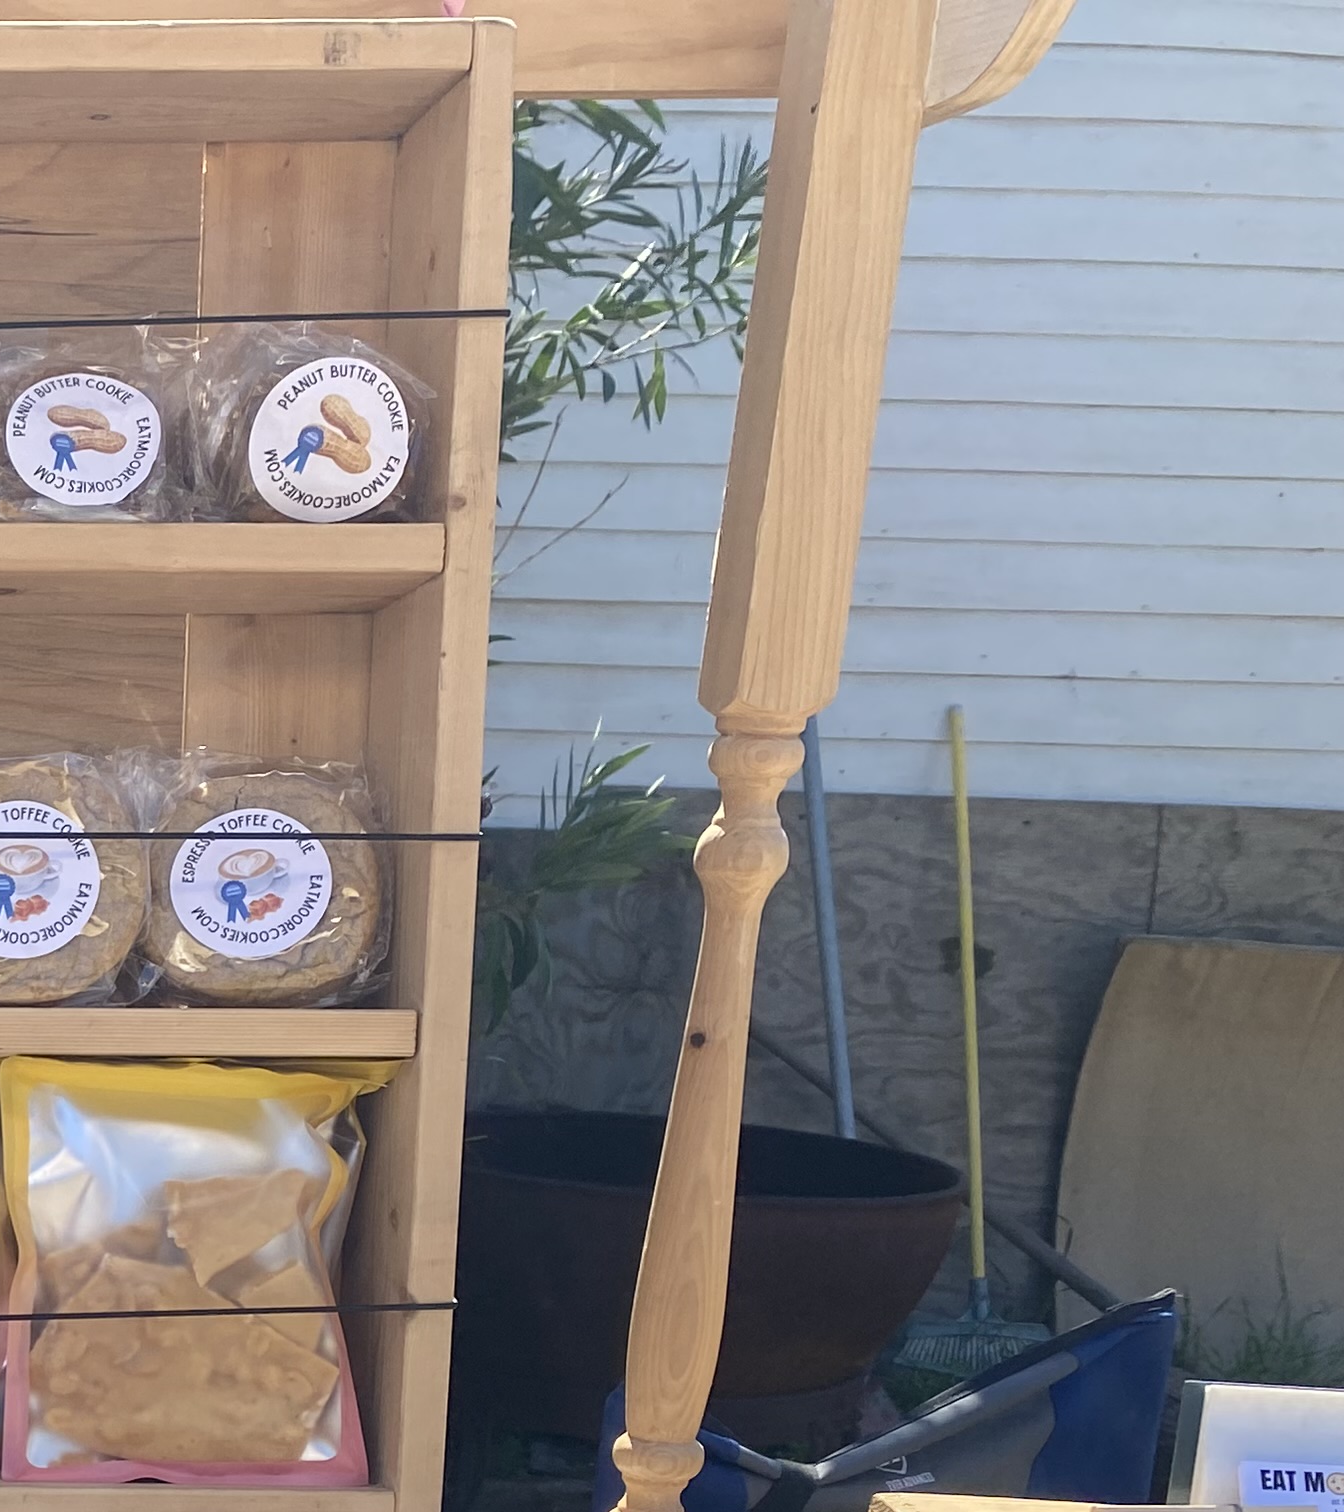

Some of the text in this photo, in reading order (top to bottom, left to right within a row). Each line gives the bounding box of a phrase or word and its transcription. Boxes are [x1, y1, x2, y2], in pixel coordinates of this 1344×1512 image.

[13, 378, 134, 437] PEANUT BUTTER COOKIE
[277, 365, 403, 432] PEANUT BUTTER COOKIE
[34, 417, 152, 493] EATMOORECOOKIES.COM
[264, 448, 401, 509] EATMOORECOOKIES.COM
[2, 807, 50, 824] TOFFEE
[219, 815, 268, 833] TOFFEE
[191, 873, 323, 944] EATMOORECOOKIES.COM
[1260, 1469, 1296, 1491] EAT
